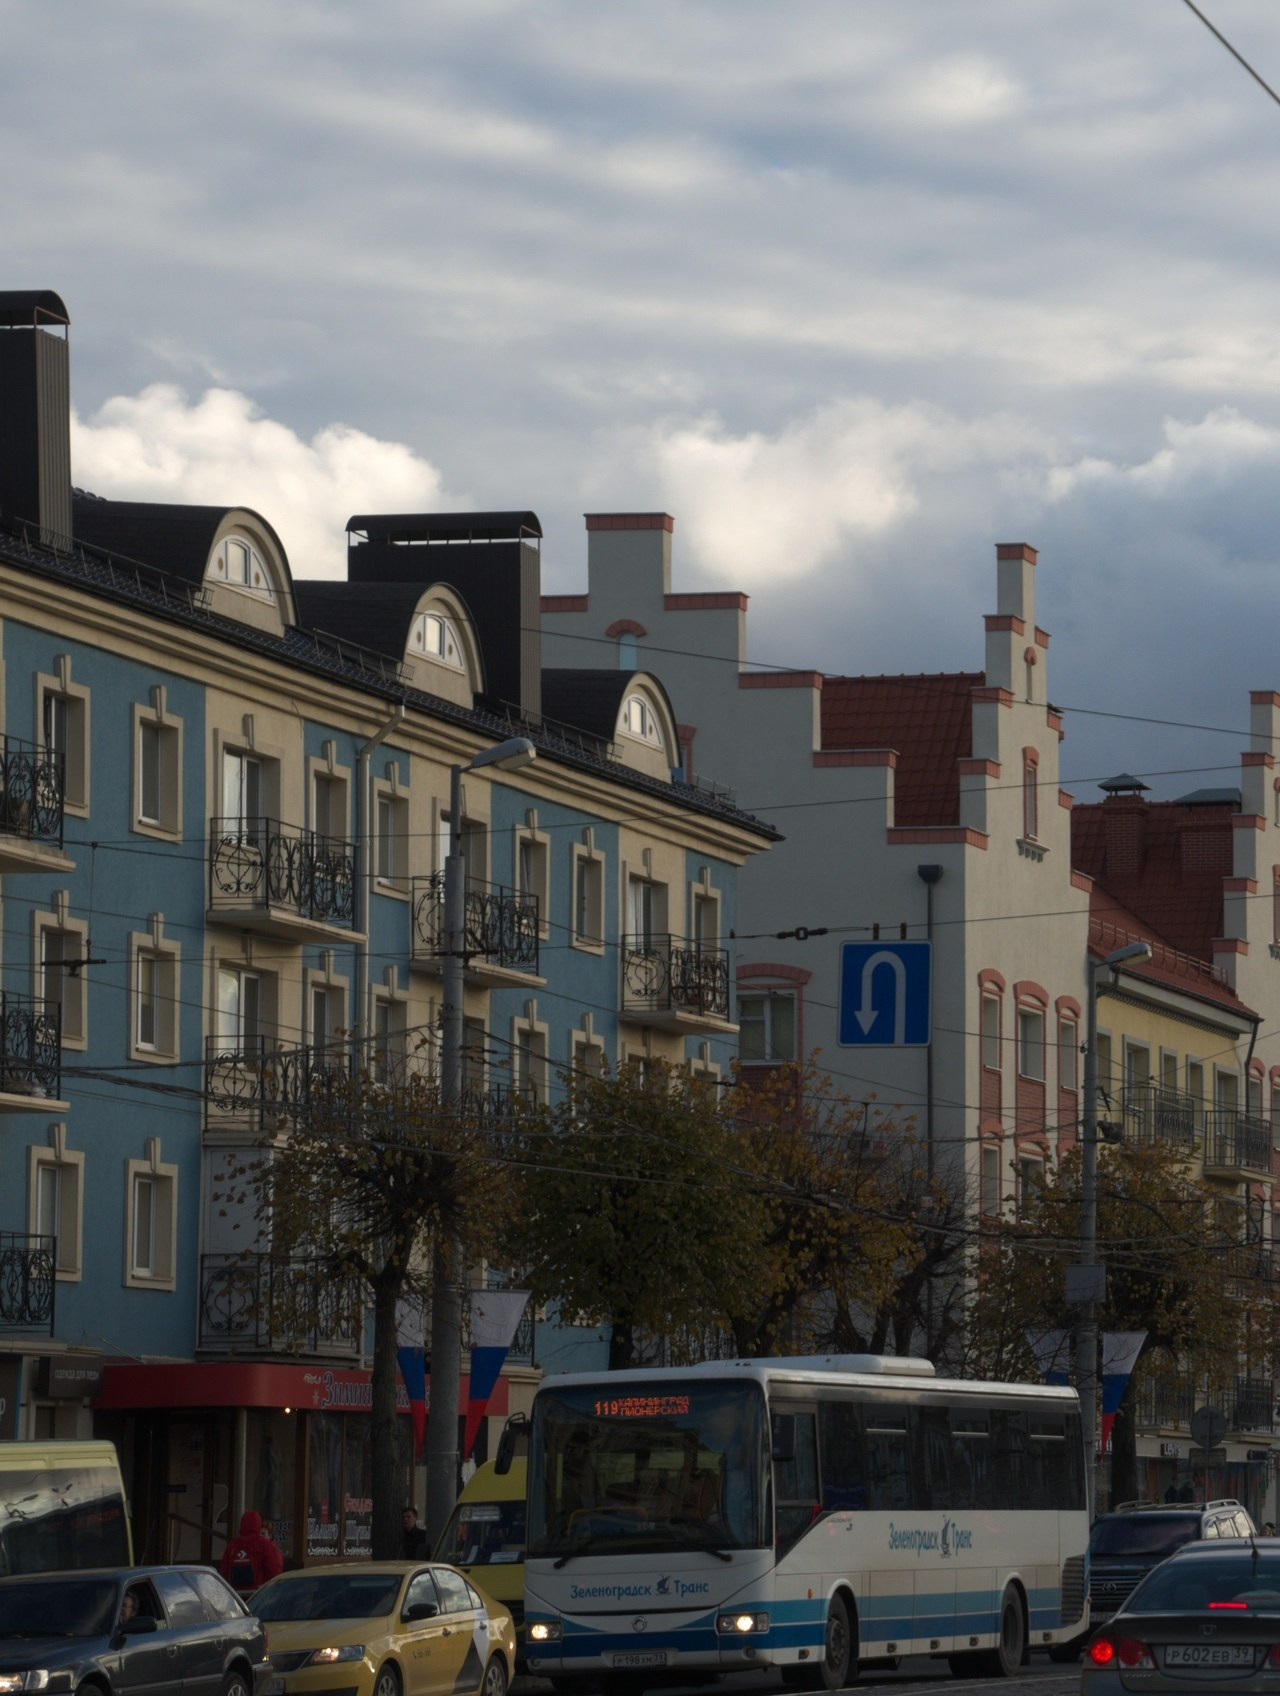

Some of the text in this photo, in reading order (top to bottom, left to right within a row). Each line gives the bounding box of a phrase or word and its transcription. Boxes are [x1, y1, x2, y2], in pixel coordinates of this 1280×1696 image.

[321, 1371, 373, 1408] Зимня
[595, 1401, 619, 1416] 119
[618, 1396, 690, 1407] КАЛИНИНГРАД
[621, 1405, 689, 1416] ПИОНЕРСКИЙ
[889, 1522, 939, 1557] Зеленоградск
[951, 1523, 972, 1556] Транс
[570, 1579, 709, 1600] Зеленоградск Транс
[1234, 1647, 1249, 1659] 39
